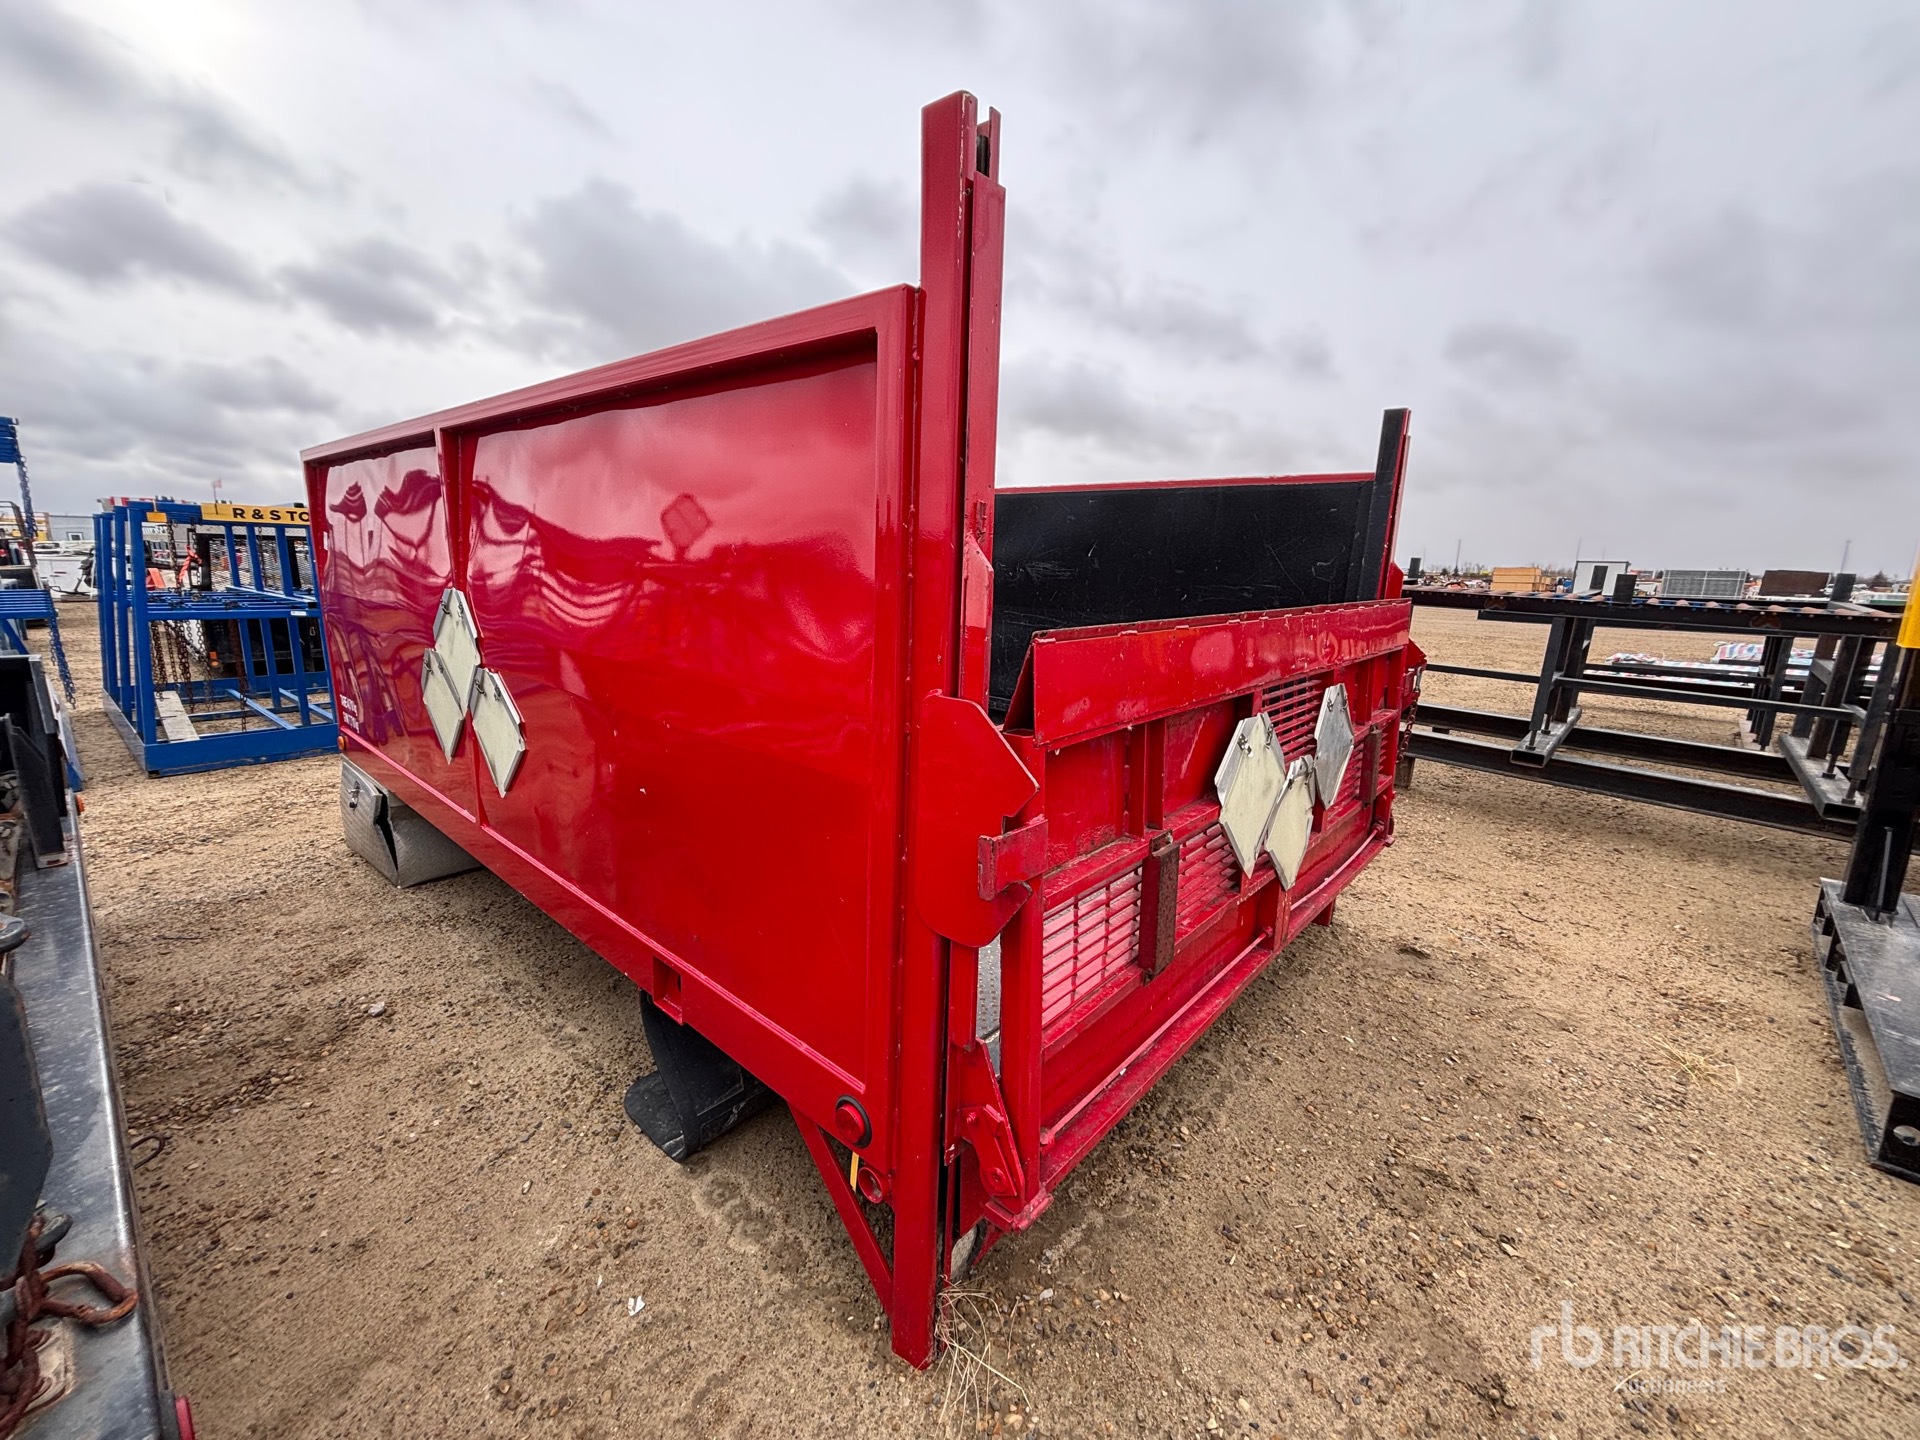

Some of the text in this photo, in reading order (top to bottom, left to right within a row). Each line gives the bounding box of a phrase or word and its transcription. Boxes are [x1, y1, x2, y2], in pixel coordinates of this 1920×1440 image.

[232, 507, 246, 519] R
[252, 508, 264, 520] &
[269, 509, 281, 521] S
